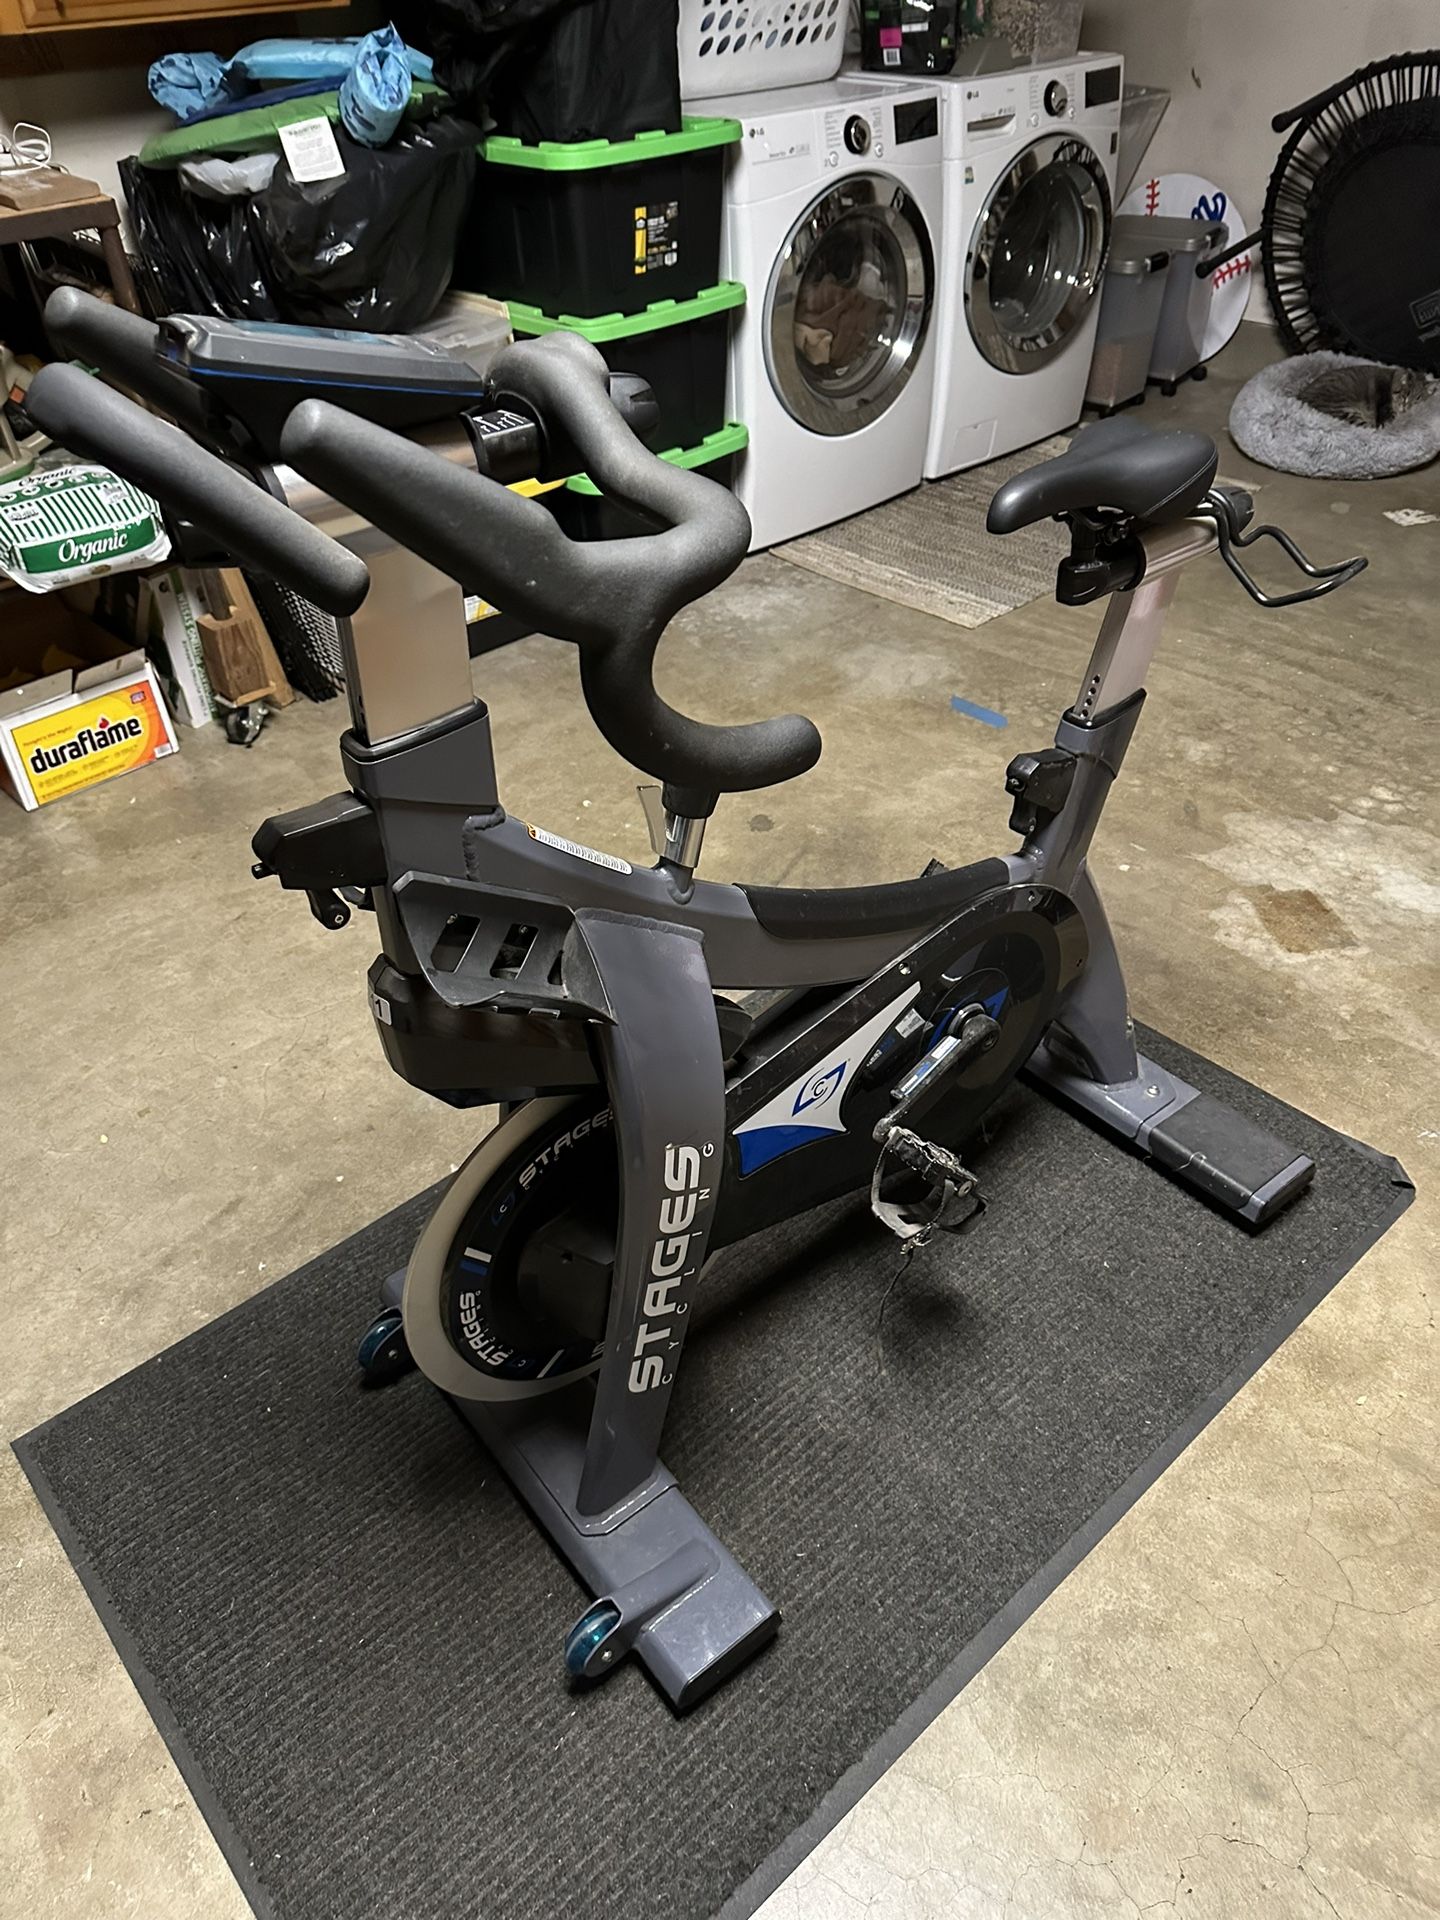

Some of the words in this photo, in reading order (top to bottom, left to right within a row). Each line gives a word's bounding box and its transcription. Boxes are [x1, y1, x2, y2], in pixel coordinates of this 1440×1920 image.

[18, 467, 77, 488] Organic
[58, 531, 128, 564] Organic
[176, 591, 193, 626] SYSTEM
[187, 627, 204, 664] PUTTING
[30, 717, 142, 774] duraflame
[628, 1145, 700, 1393] STAGES
[662, 1143, 714, 1385] CYCLING
[459, 1291, 510, 1366] STAGES
